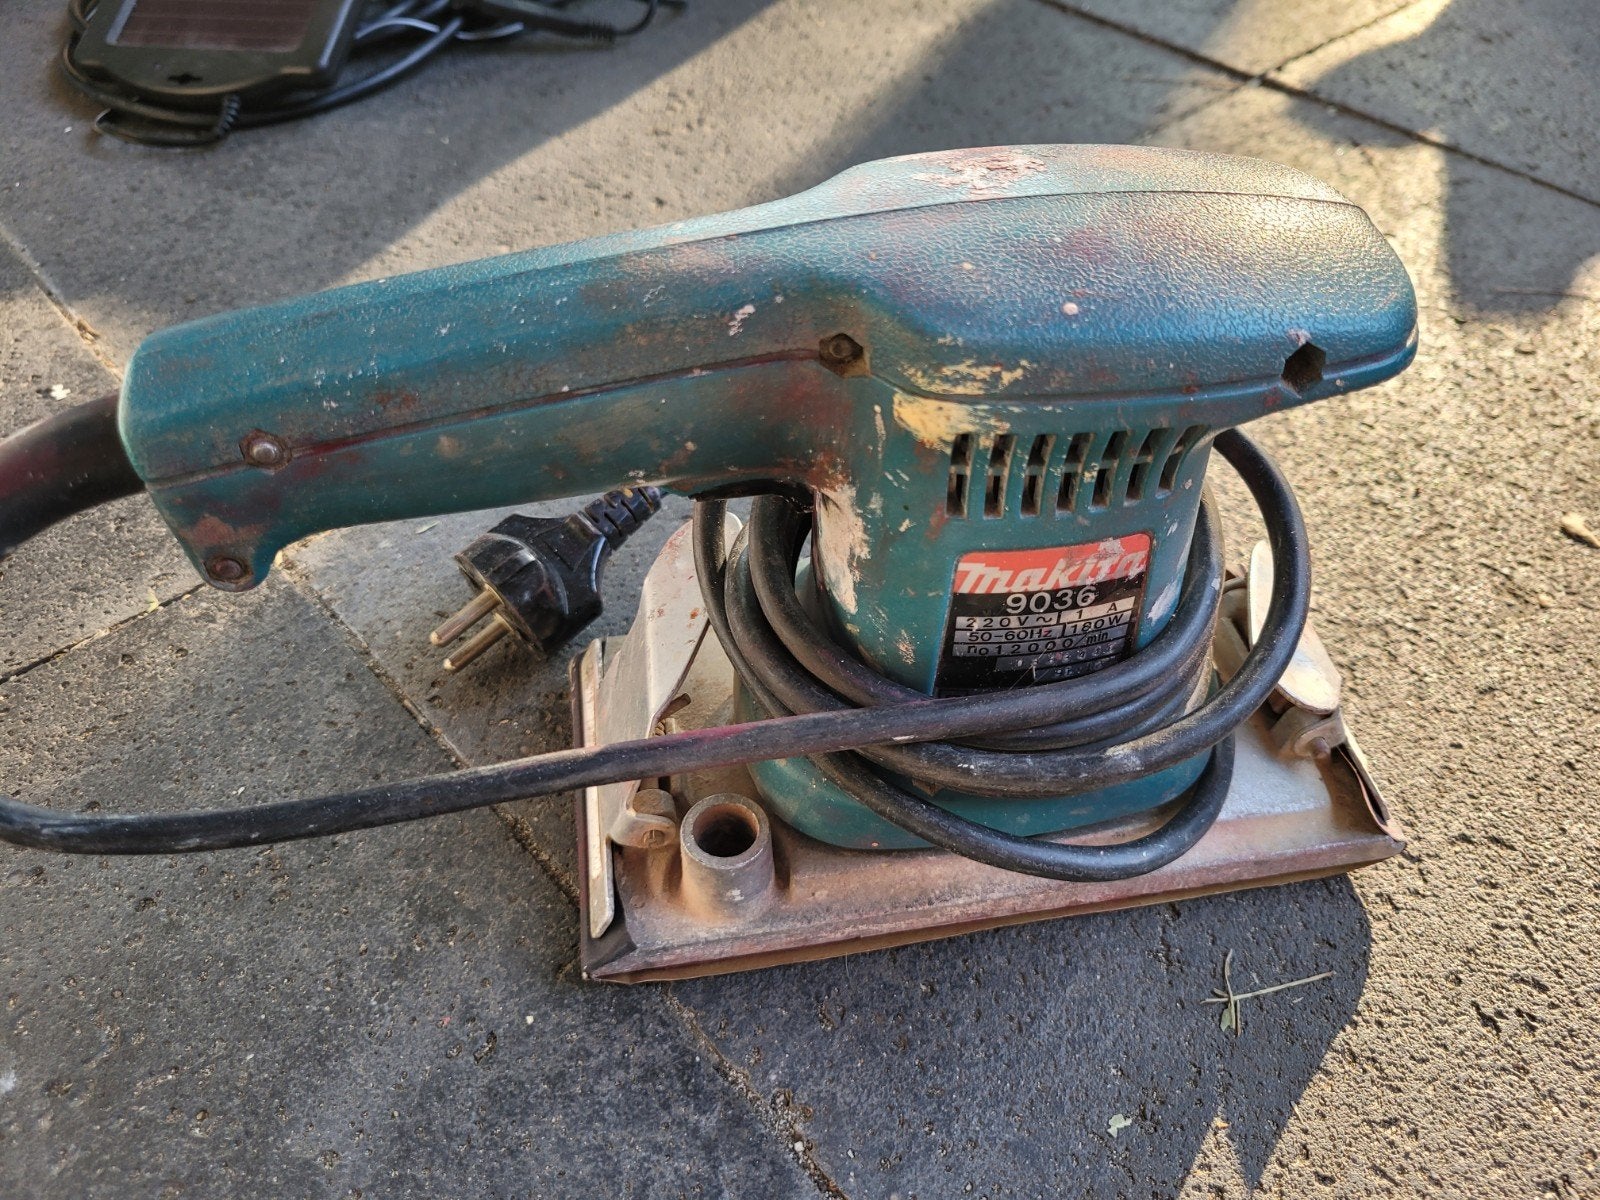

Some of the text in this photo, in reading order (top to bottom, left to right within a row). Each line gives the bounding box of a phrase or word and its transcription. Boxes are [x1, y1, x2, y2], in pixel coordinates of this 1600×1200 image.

[953, 549, 1148, 593] makita
[1006, 585, 1097, 614] 9036
[1076, 602, 1118, 620] 1 A
[1071, 613, 1123, 634] 180W
[968, 628, 1053, 642] 50-60Hz
